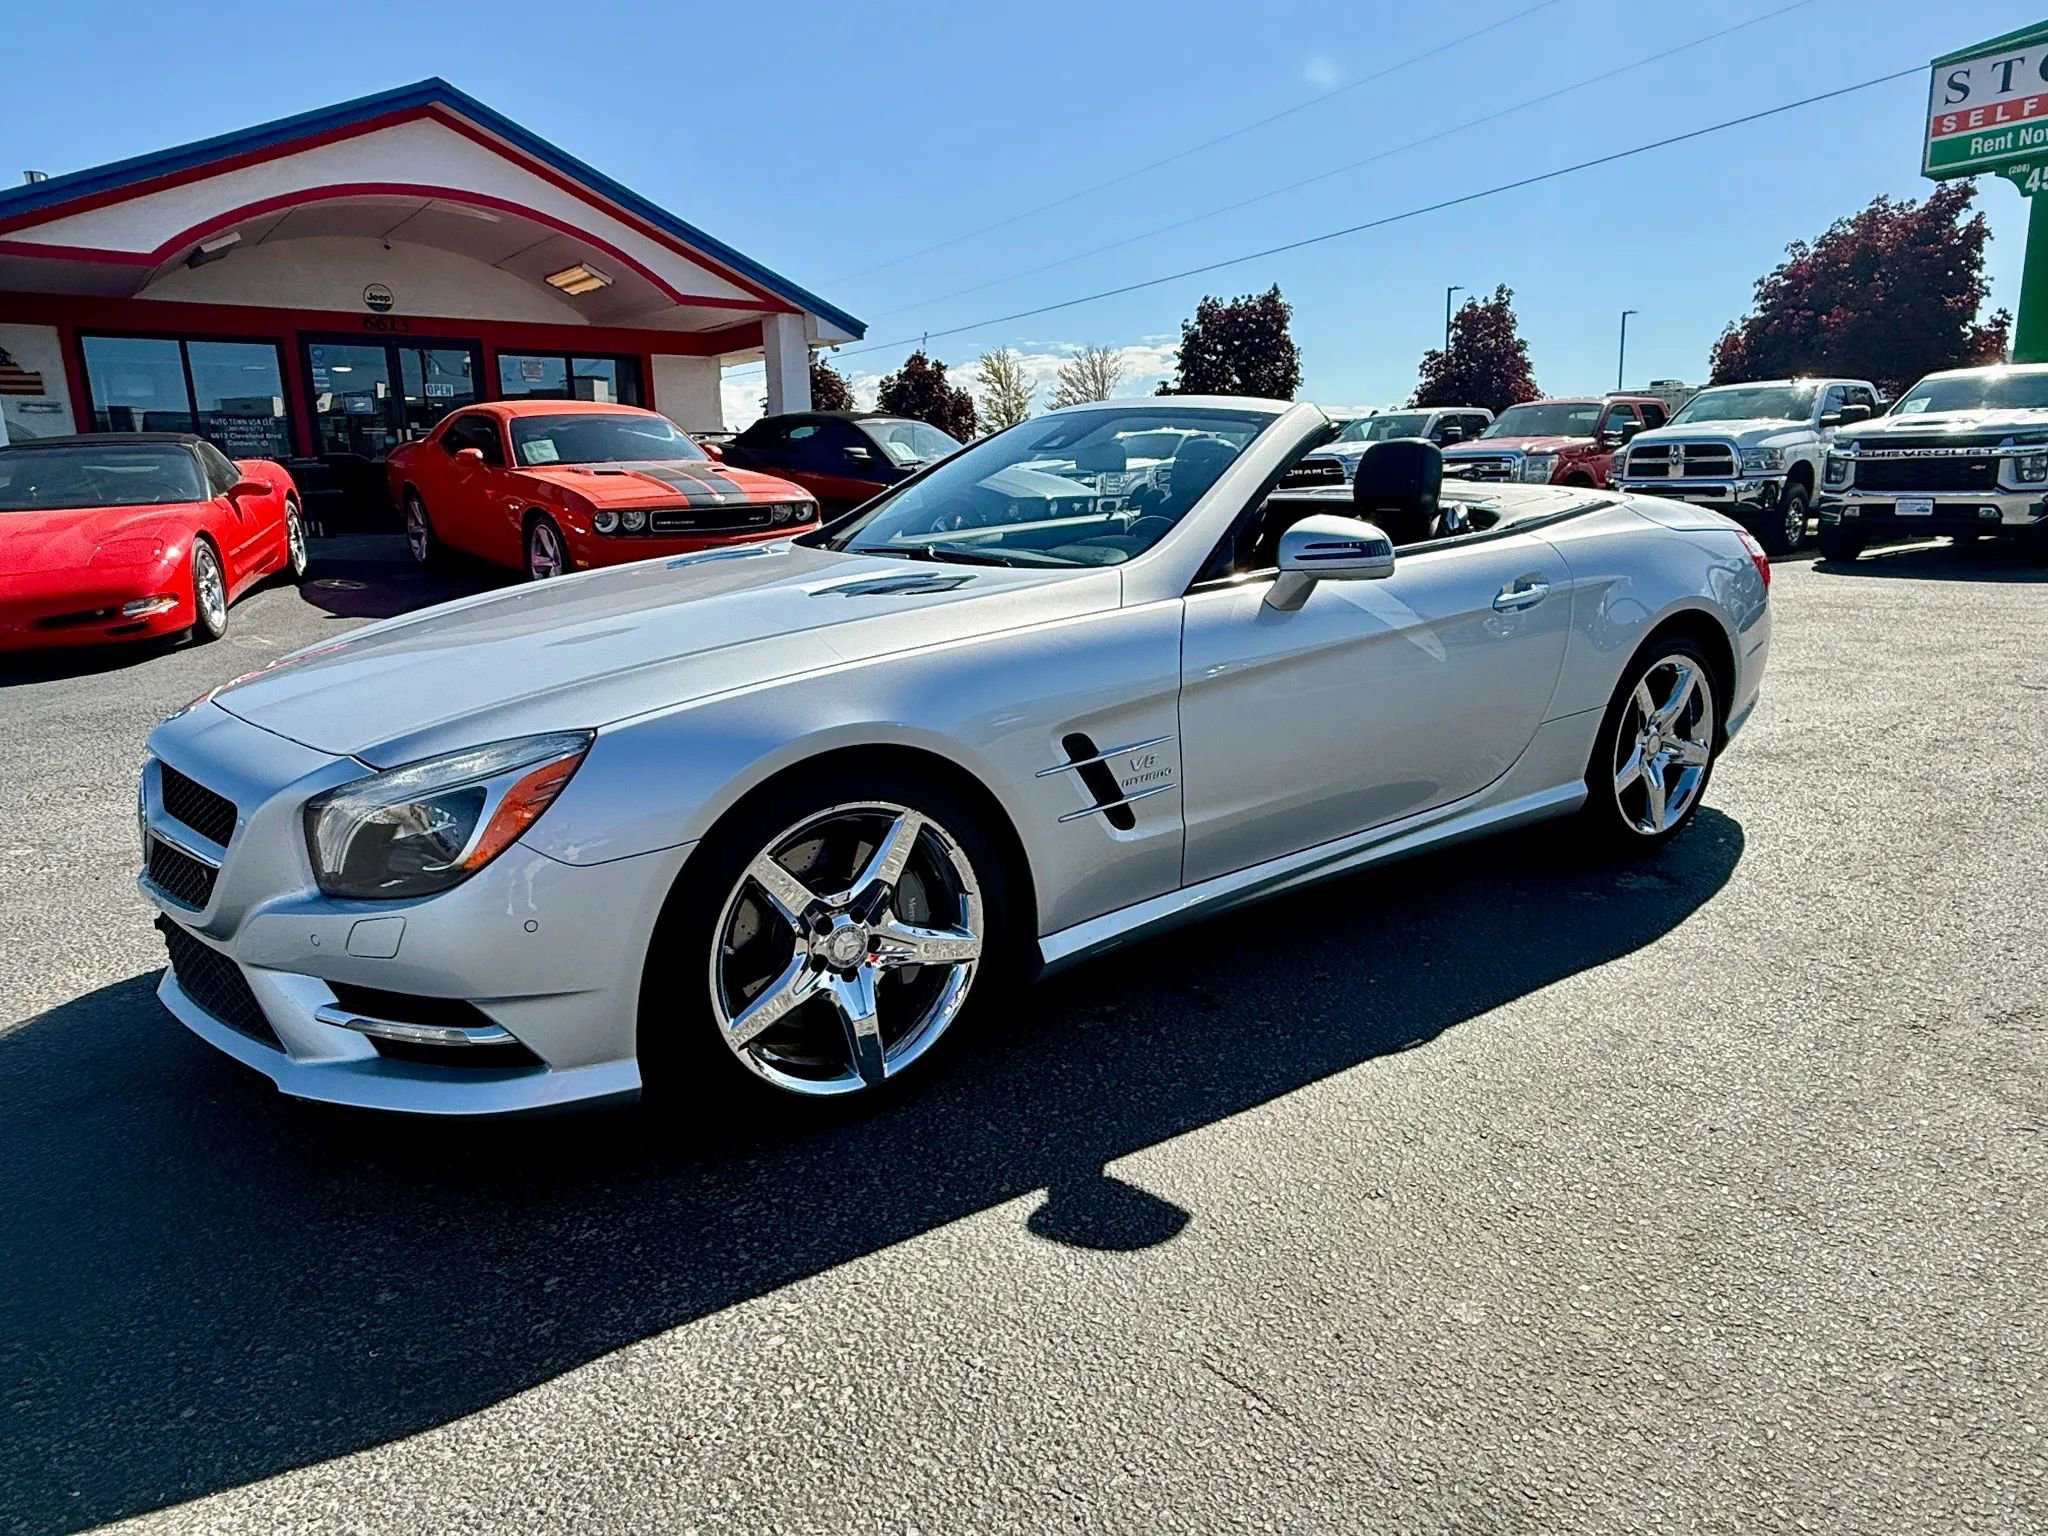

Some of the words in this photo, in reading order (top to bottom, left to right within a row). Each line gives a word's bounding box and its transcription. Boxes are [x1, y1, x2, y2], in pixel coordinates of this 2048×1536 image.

[1942, 98, 2039, 133] SELF
[1970, 131, 2013, 156] Rent
[367, 292, 391, 303] Jeep
[427, 385, 453, 396] OPEN
[229, 432, 265, 440] Cleveland
[1859, 448, 1998, 458] CHEVROLET
